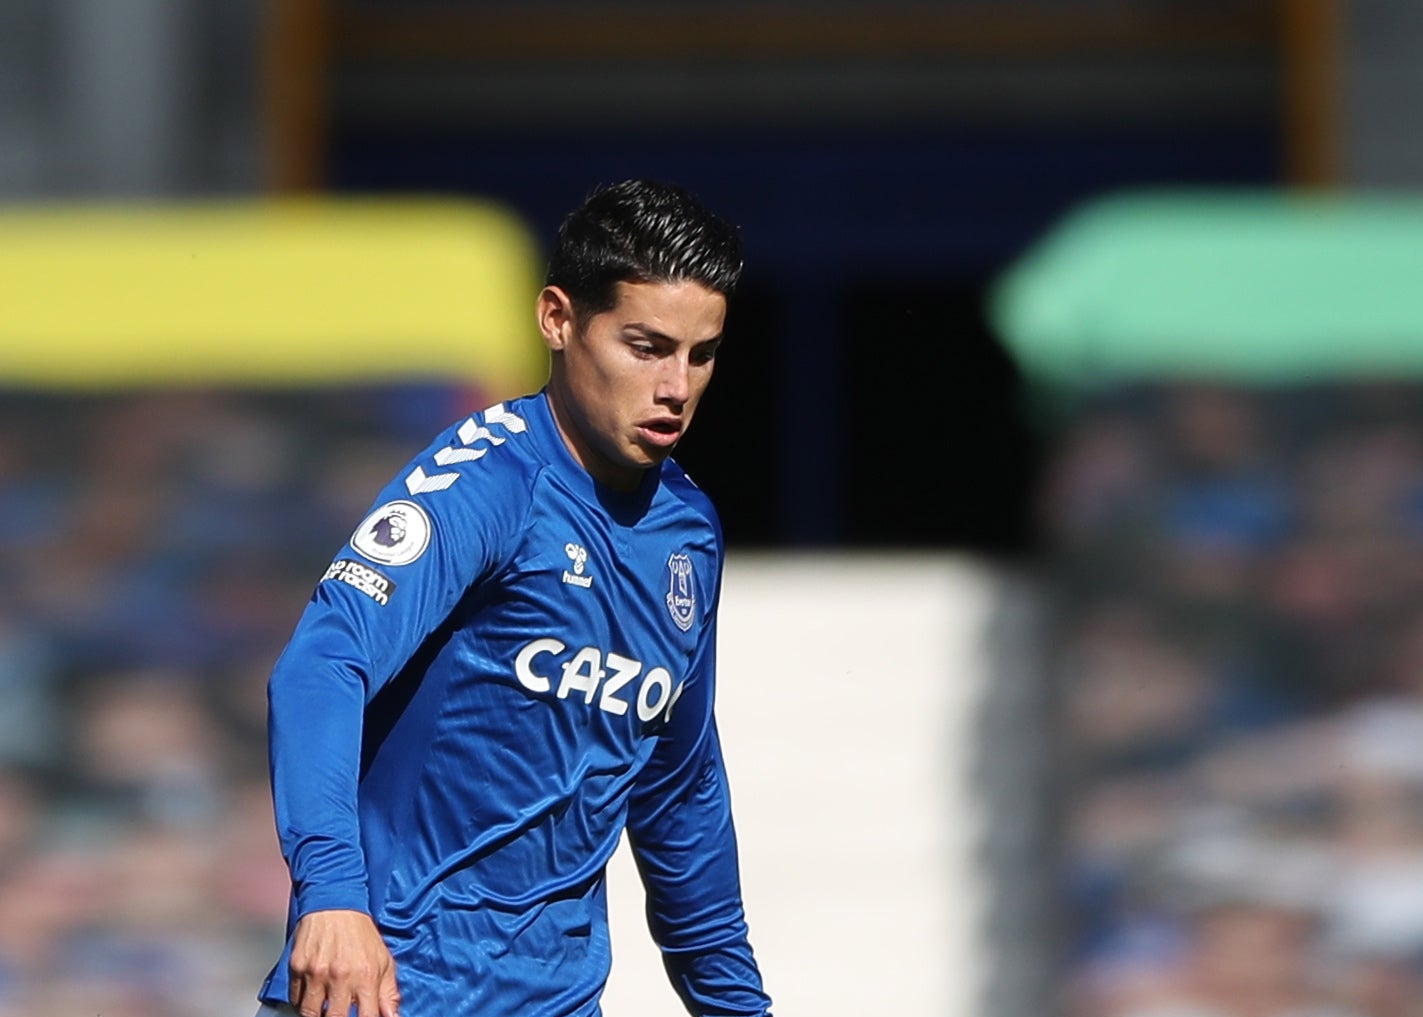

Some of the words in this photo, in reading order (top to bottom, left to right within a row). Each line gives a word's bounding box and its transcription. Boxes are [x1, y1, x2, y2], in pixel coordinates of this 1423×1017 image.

[338, 571, 389, 605] racism
[346, 563, 389, 592] room
[561, 570, 593, 589] hummel
[515, 638, 685, 723] CAZO
